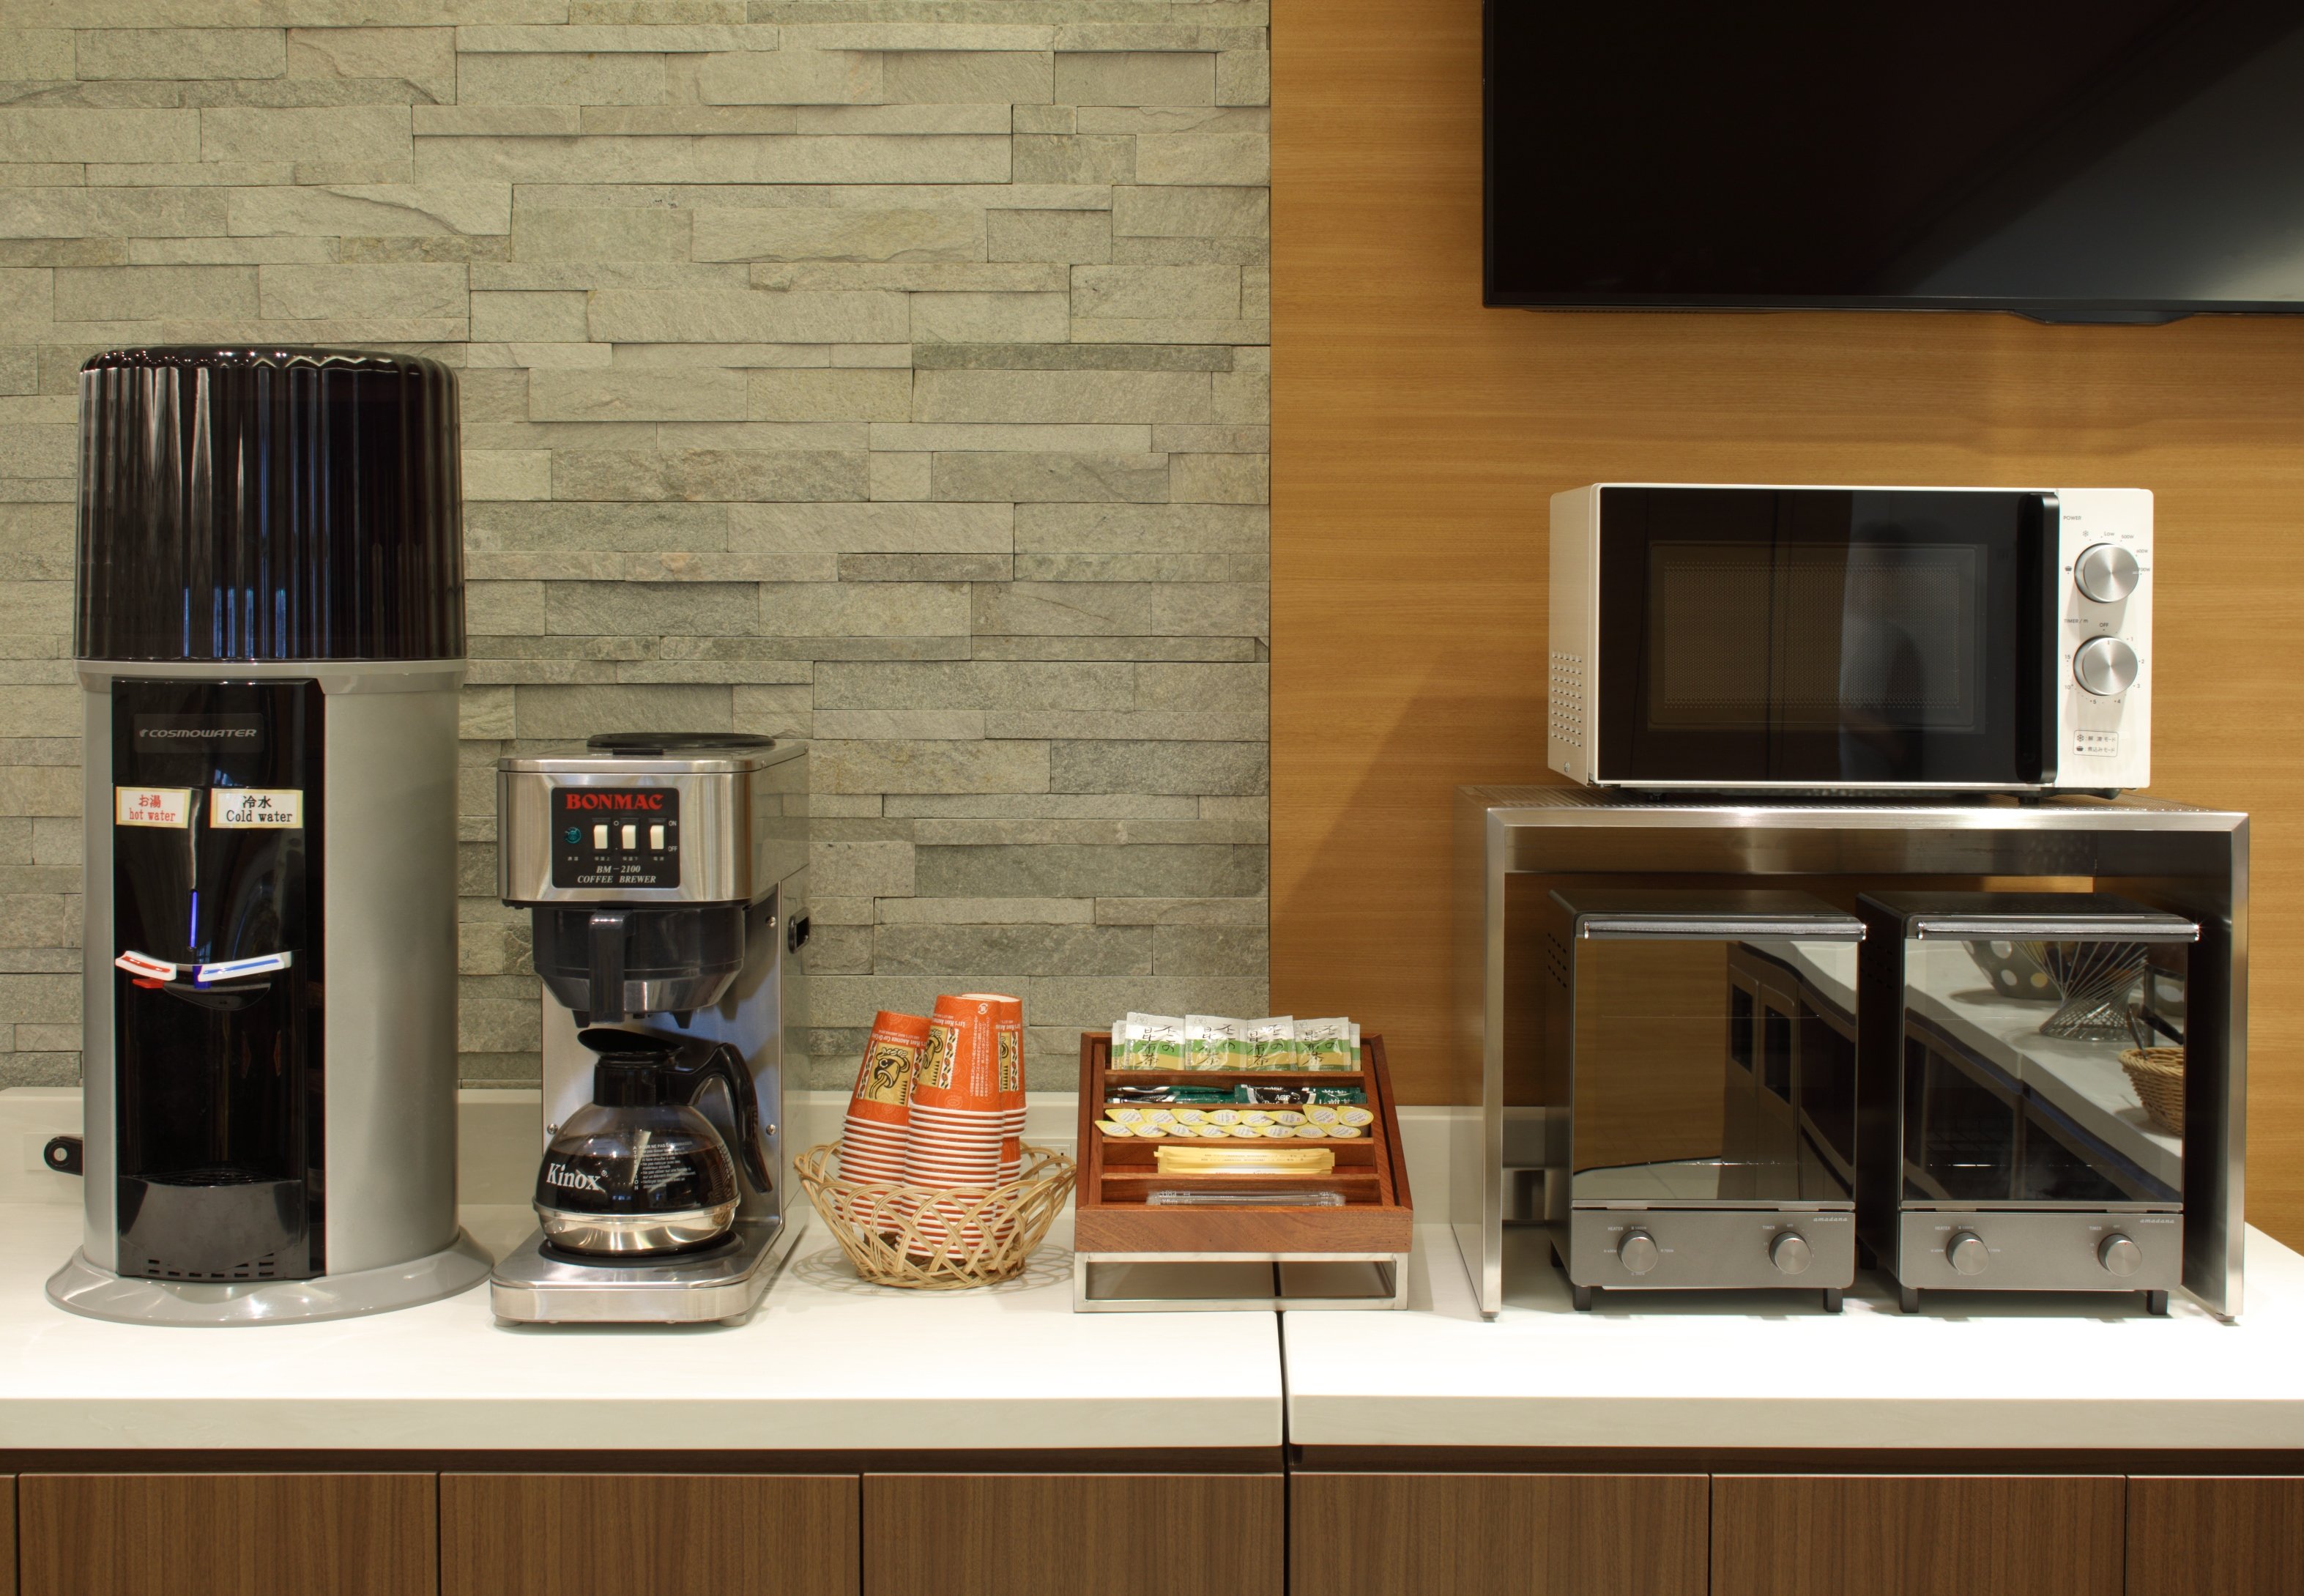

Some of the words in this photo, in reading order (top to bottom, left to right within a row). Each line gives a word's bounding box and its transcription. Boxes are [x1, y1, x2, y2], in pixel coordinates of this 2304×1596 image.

[149, 729, 256, 738] COSMOWATER
[138, 794, 161, 809] お湯
[242, 795, 272, 809] 冷水
[565, 793, 664, 810] BONMAC
[129, 808, 144, 820] hot
[148, 809, 176, 822] water
[226, 809, 253, 823] Cold
[259, 812, 293, 823] water
[577, 875, 614, 883] COFFEE
[619, 875, 656, 883] BREWER
[546, 1162, 601, 1191] Kinox
